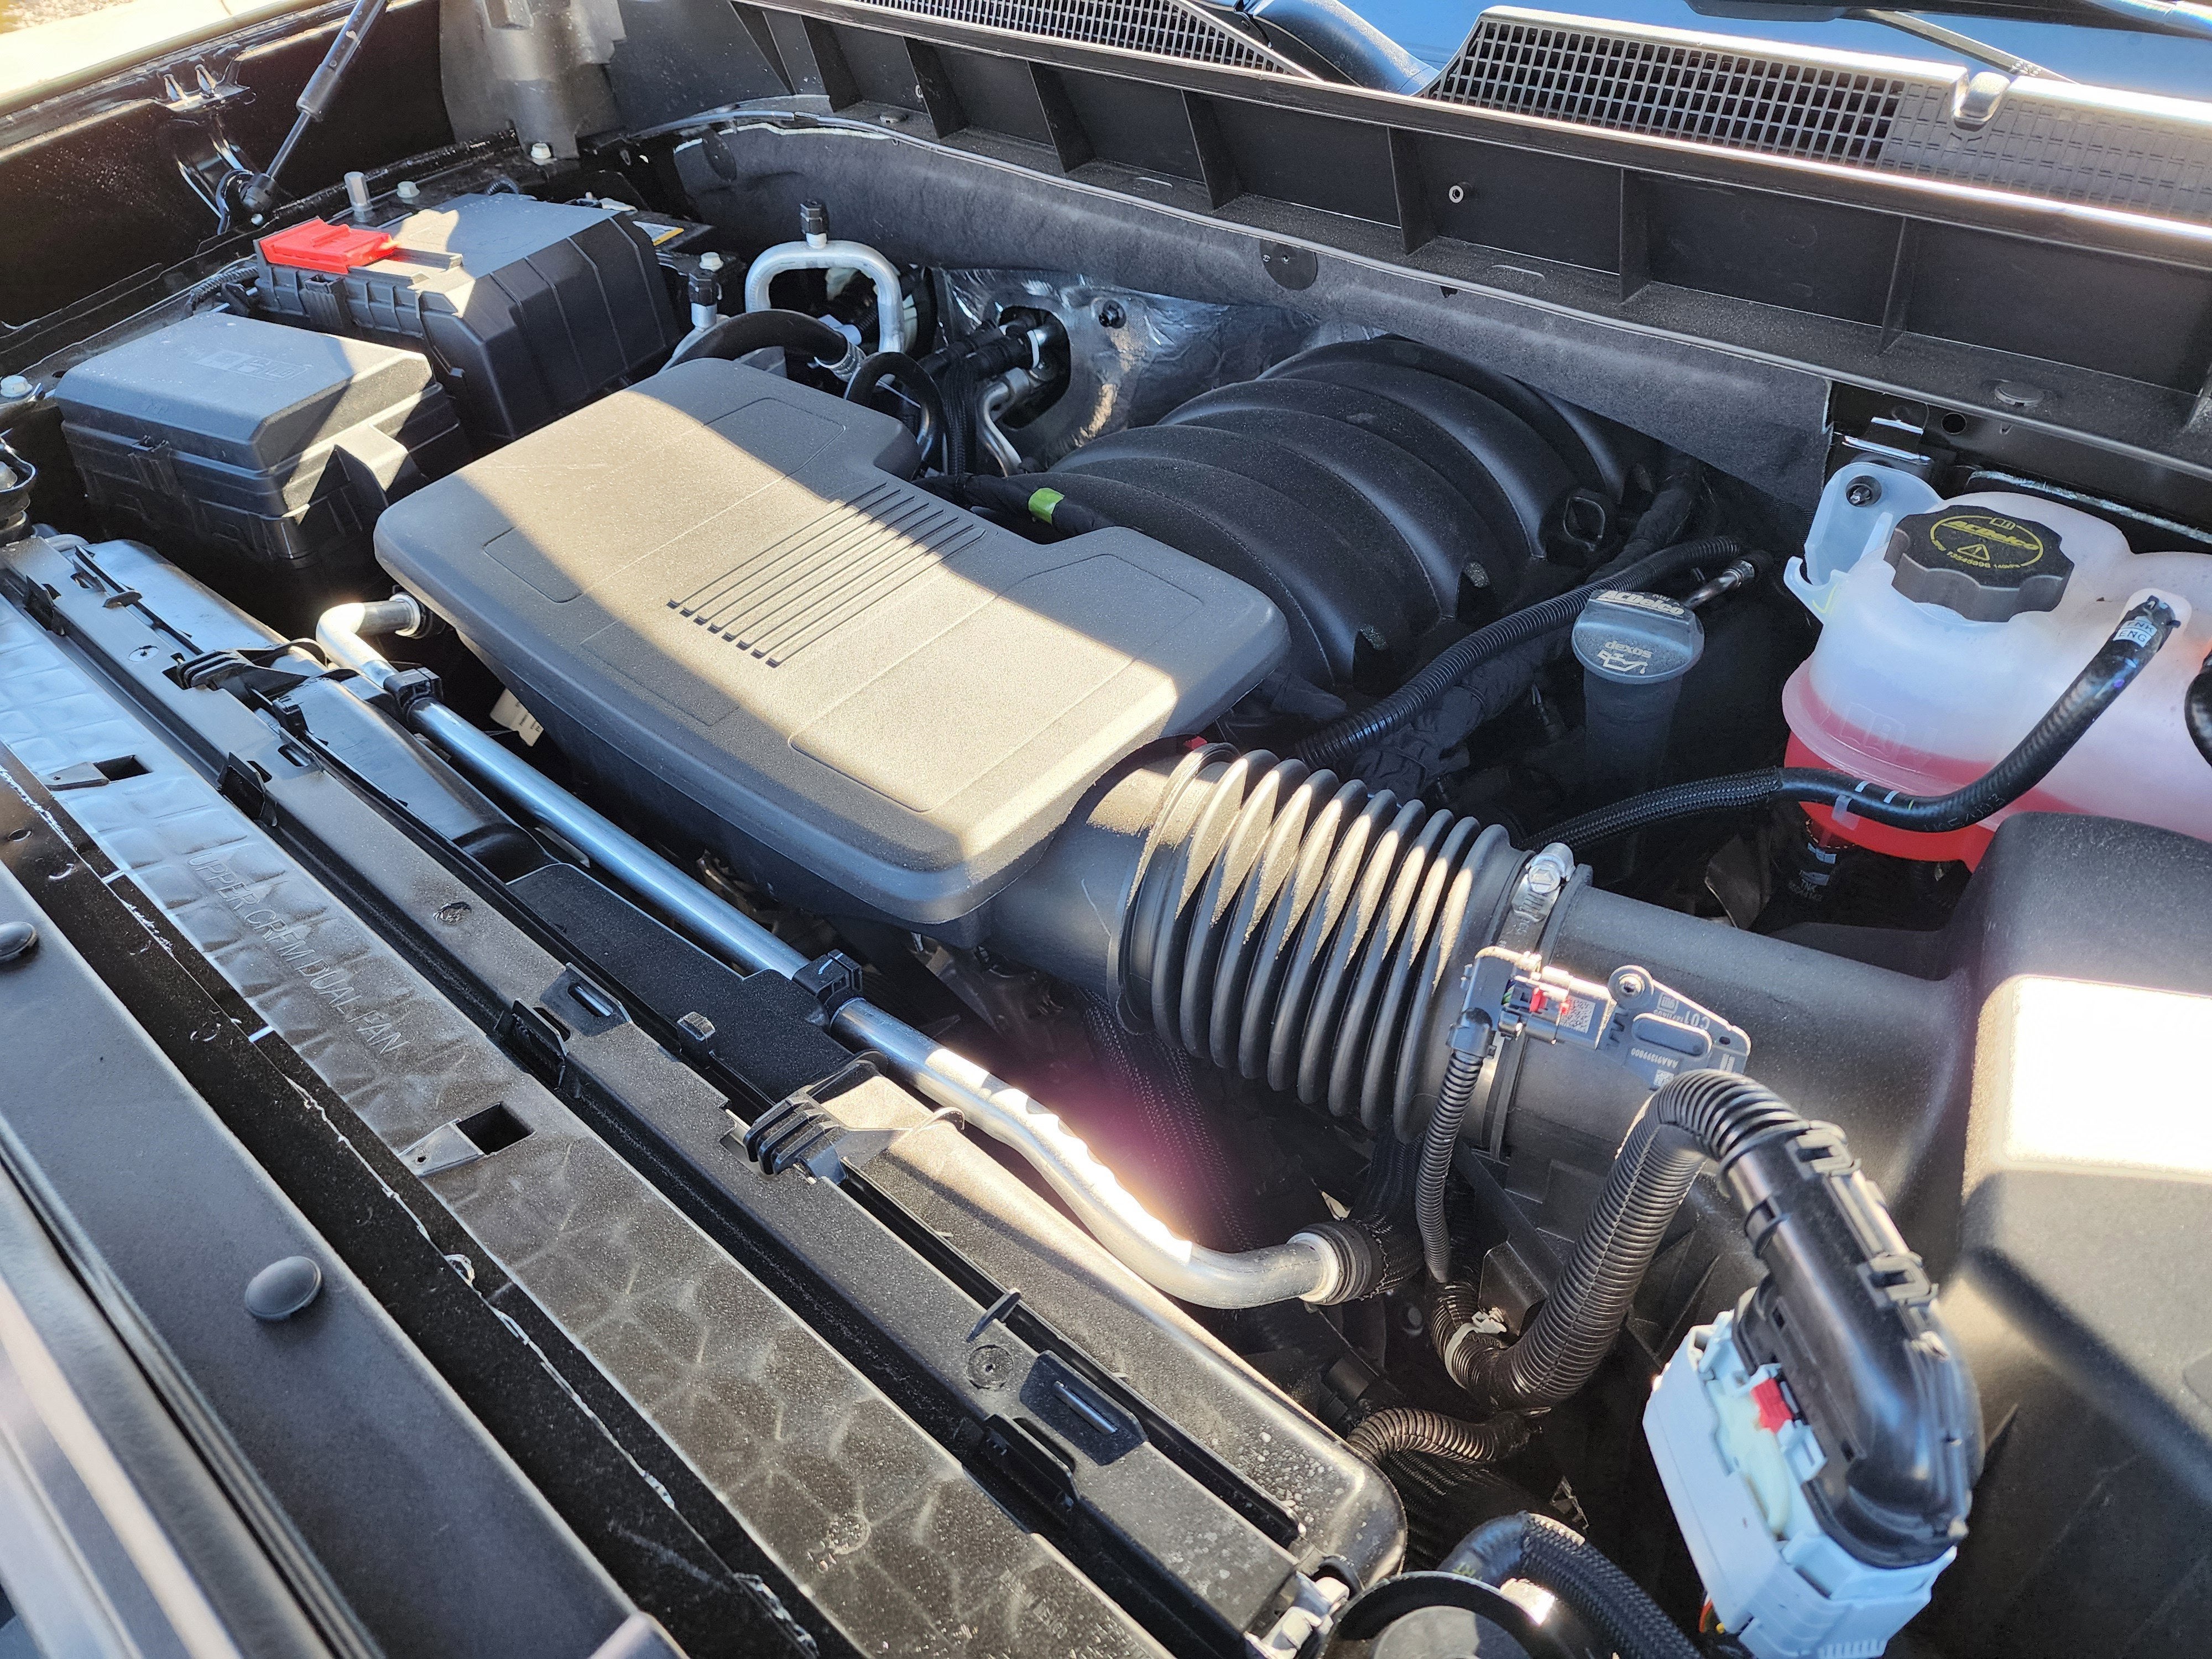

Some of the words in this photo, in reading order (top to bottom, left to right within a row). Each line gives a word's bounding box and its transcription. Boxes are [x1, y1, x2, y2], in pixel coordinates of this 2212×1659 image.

[1942, 521, 2040, 550] ACDelco
[1596, 590, 1685, 617] ACDelco
[1604, 640, 1653, 658] dexos
[2119, 630, 2147, 642] ENG
[187, 852, 260, 911] UPPER
[244, 909, 316, 962] CRFM
[294, 958, 363, 1015] DUAL
[348, 1010, 411, 1055] FAN
